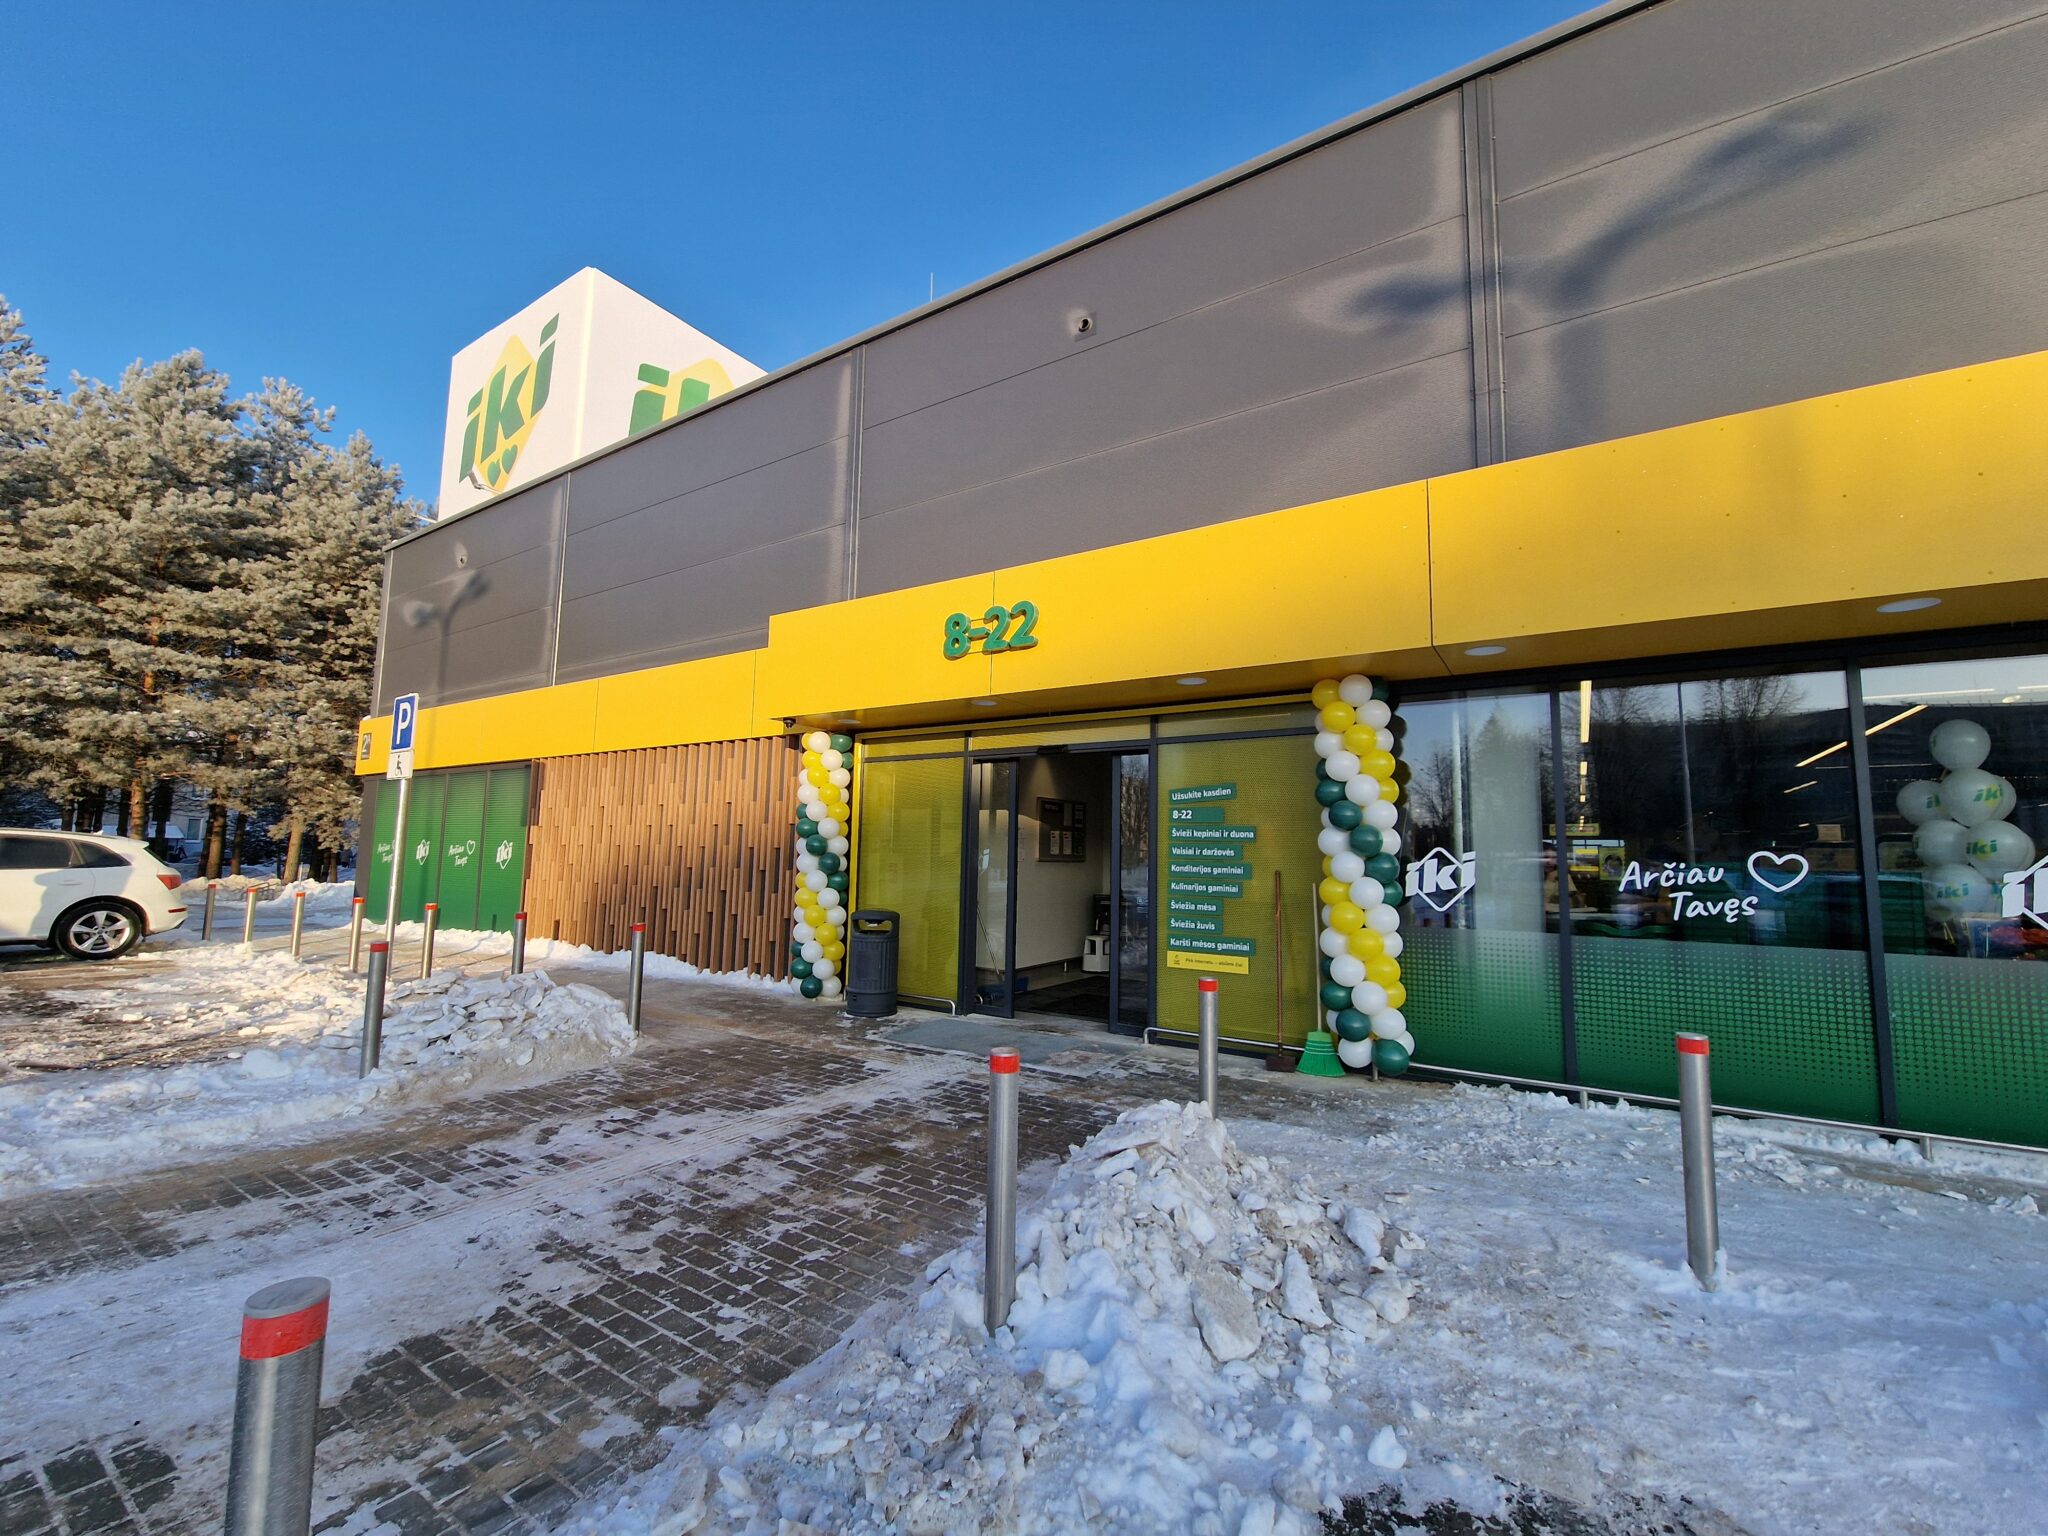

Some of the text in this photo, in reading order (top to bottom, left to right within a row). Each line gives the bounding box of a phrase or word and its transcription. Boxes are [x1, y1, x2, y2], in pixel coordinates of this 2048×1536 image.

[458, 312, 560, 484] iki
[943, 601, 1039, 661] 8-22
[396, 701, 412, 745] P
[1172, 788, 1232, 800] Užsukite kasdien
[1172, 810, 1192, 819] 8-22
[1172, 828, 1254, 839] Švieži kepiniai ir duona
[1172, 847, 1235, 857] Vaisiai ir daržovės
[1966, 840, 1998, 856] iki
[1171, 864, 1244, 875] Konditerijos gaminiai
[1405, 851, 1476, 897] iki
[1618, 861, 1725, 893] Arčiau
[1171, 882, 1238, 893] Kulinarijos gaminiai
[1170, 900, 1216, 911] Šviežia mėsa
[1668, 892, 1759, 924] Tavęs
[1170, 918, 1215, 930] Šviežia žuvis
[1170, 937, 1249, 951] Karšti mėsos gaminiai
